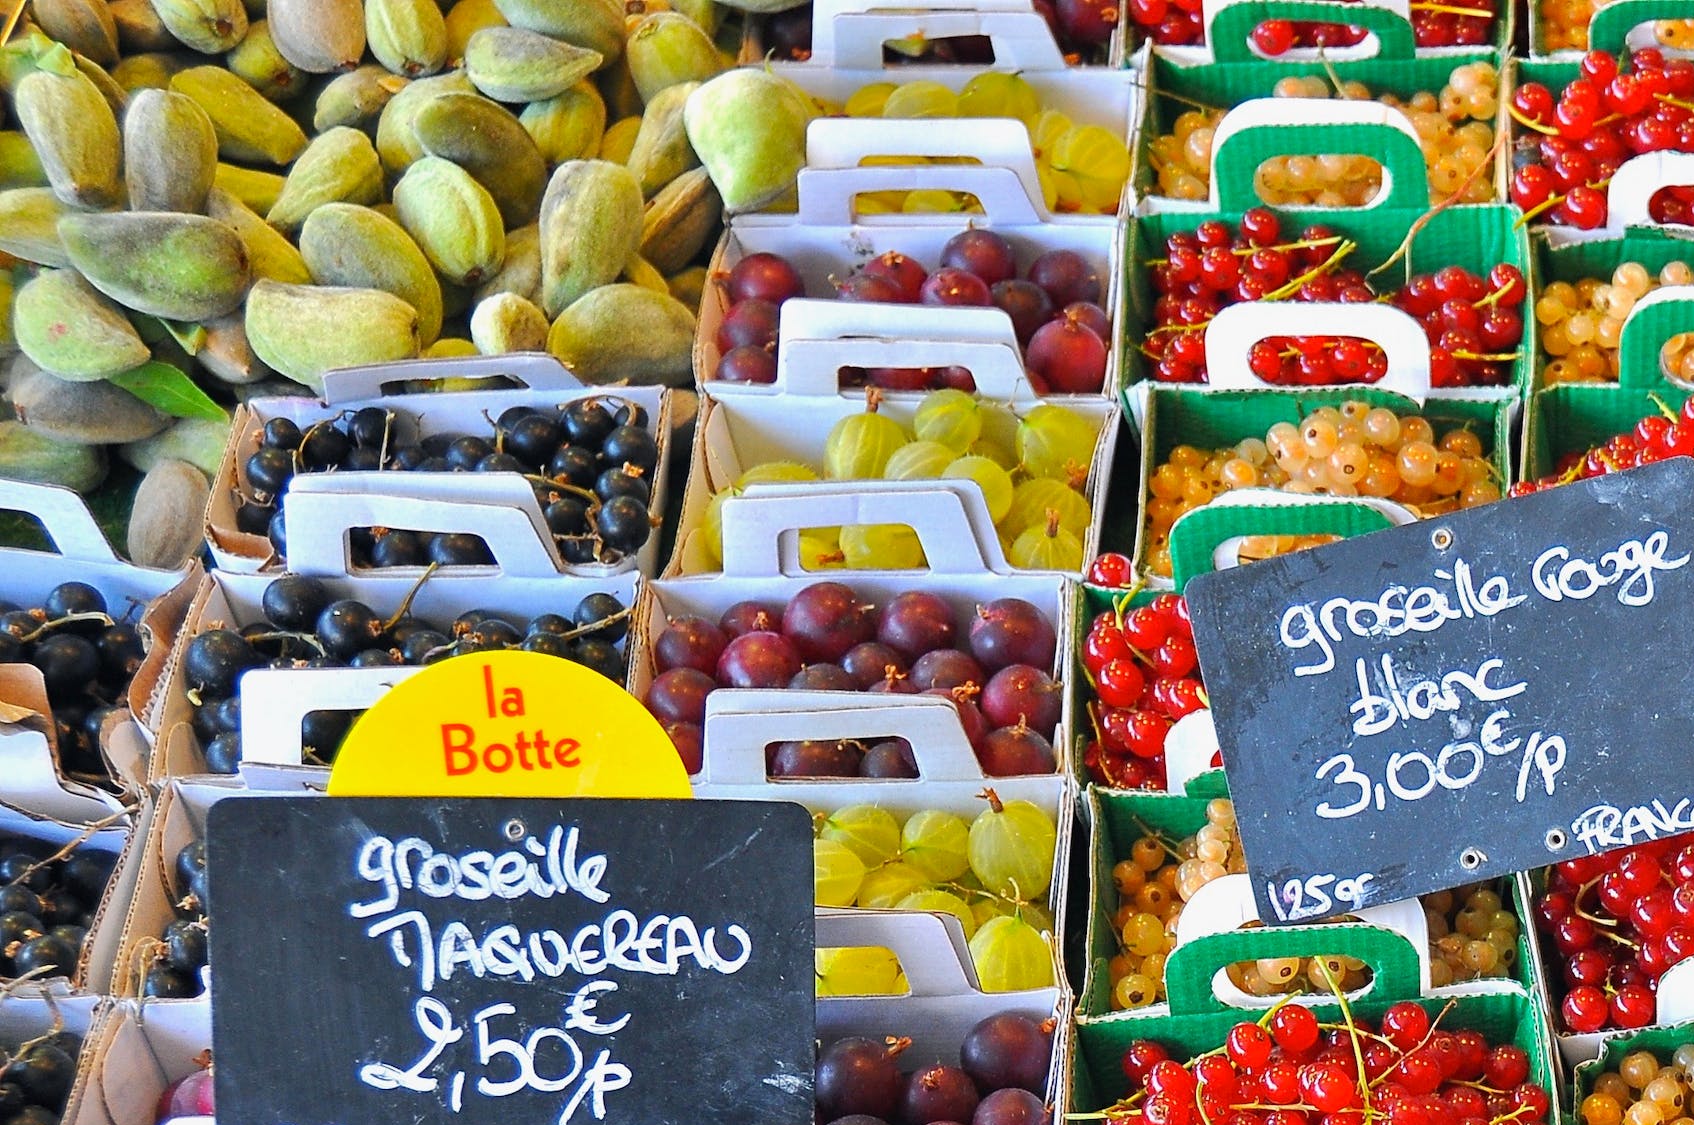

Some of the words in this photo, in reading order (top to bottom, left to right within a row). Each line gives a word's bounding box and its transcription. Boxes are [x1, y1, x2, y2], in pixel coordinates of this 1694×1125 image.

[1280, 557, 1529, 677] groseille
[482, 664, 526, 719] la
[1349, 652, 1529, 736] blanc
[441, 722, 582, 778] Botte
[350, 824, 611, 919] groseille
